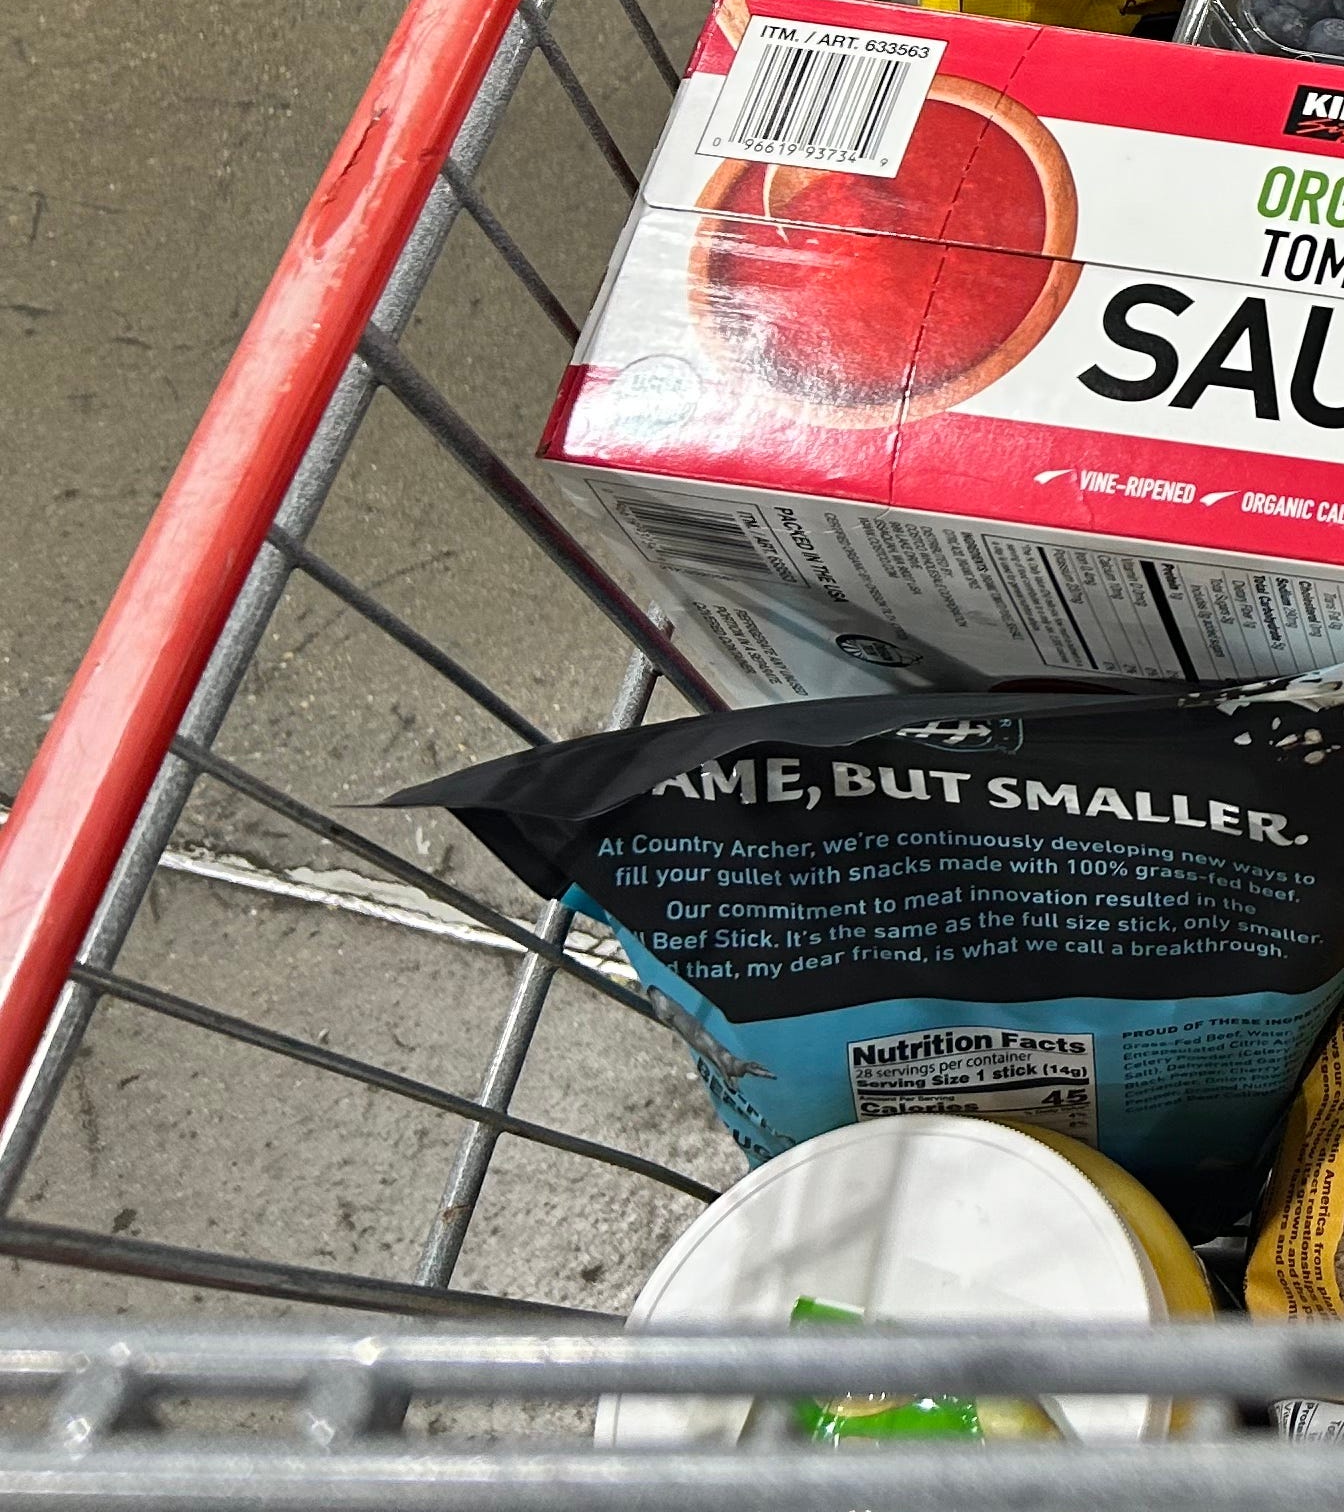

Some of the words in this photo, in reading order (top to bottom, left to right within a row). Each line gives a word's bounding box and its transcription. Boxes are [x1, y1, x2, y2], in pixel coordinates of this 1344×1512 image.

[761, 25, 800, 42] ITM.
[818, 35, 859, 50] ART.
[865, 39, 930, 59] 633563
[743, 139, 798, 156] 96619
[805, 146, 857, 164] 93734
[1079, 468, 1197, 504] VINE-RIPENED
[1241, 490, 1314, 520] ORGANIC
[652, 758, 822, 811] AME,
[831, 761, 972, 804] BUT
[987, 776, 1310, 848] SMALLER.
[598, 838, 625, 857] At
[631, 834, 725, 858] Country
[731, 839, 816, 859] Archer,
[822, 833, 890, 855] we're
[897, 830, 1045, 852] continuously
[1051, 836, 1174, 862] developing
[1182, 851, 1227, 868] new
[1234, 862, 1288, 884] ways
[1296, 872, 1316, 886] to
[616, 865, 648, 886] fill
[656, 866, 711, 888] your
[717, 866, 782, 888] gullet
[789, 866, 841, 886] with
[849, 856, 931, 882] snacks
[939, 856, 1003, 873] made
[1009, 856, 1059, 875] with
[1066, 859, 1128, 877] 100%
[1135, 864, 1242, 890] grass-fed
[1249, 882, 1300, 903] beef.
[666, 900, 712, 921] Our
[718, 899, 867, 920] commitment
[874, 896, 896, 914] to
[904, 888, 963, 912] meat
[970, 885, 1088, 907] innovation
[1095, 890, 1190, 908] resulted
[1197, 893, 1217, 909] in
[1222, 896, 1257, 915] the
[853, 1031, 993, 1067] Nutrition
[1001, 1031, 1088, 1054] Facts
[856, 1068, 873, 1079] 28
[876, 1063, 935, 1078] servings
[939, 1060, 964, 1075] per
[967, 1051, 1033, 1069] container
[857, 1078, 926, 1089] Serving
[931, 1073, 970, 1087] Size
[976, 1069, 984, 1082] 1
[992, 1063, 1038, 1081] stick
[1043, 1063, 1088, 1078] (14g)
[1041, 1089, 1089, 1106] 45
